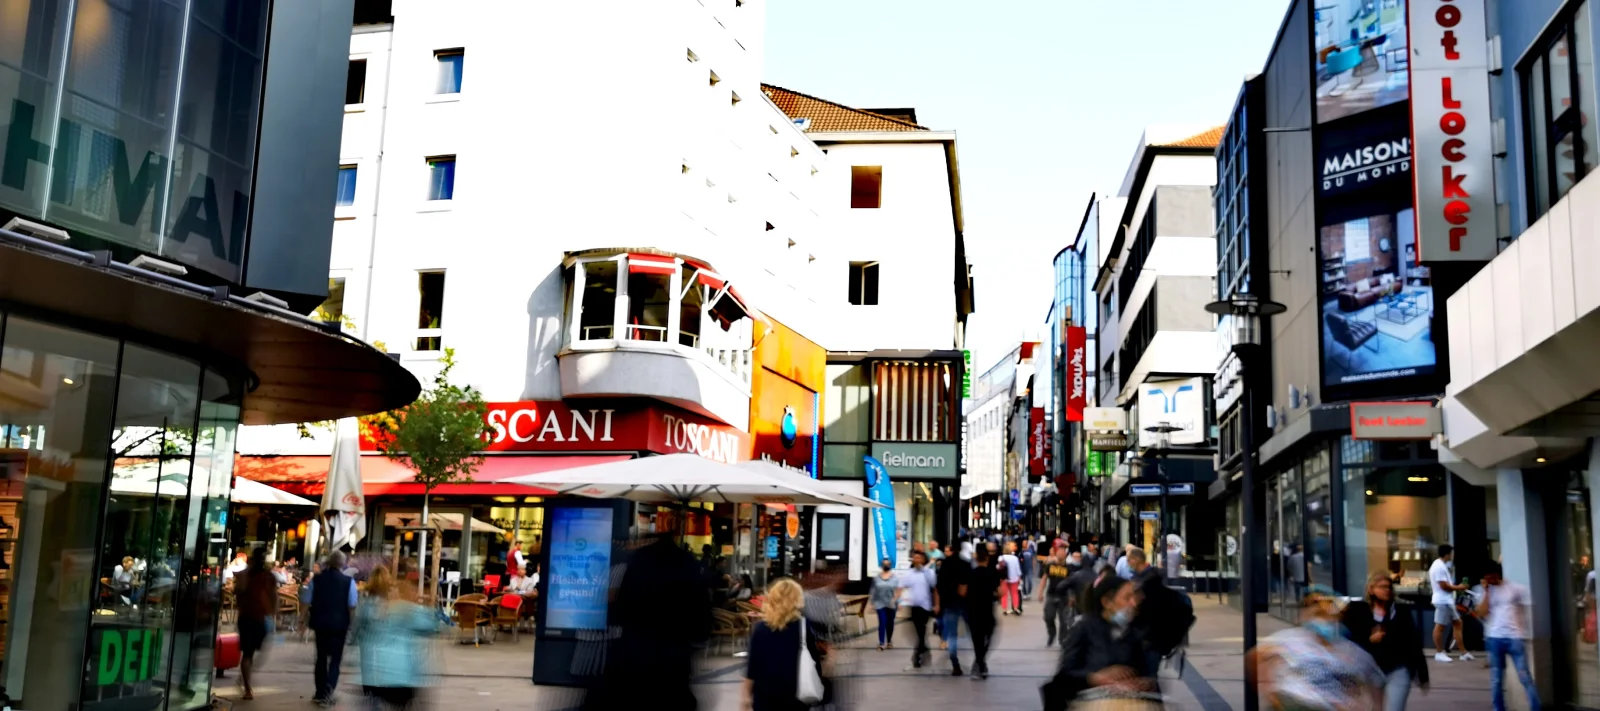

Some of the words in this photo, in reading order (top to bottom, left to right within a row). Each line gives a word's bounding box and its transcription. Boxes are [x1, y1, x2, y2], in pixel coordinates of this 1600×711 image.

[1435, 0, 1461, 60] ot
[1323, 137, 1411, 175] MAISON
[1440, 77, 1471, 252] Locker
[1323, 178, 1344, 190] DU
[1357, 161, 1409, 182] MOND
[1340, 368, 1416, 383] maisonsdumonde.com
[484, 408, 615, 444] SCANI
[663, 414, 740, 465] TOSCANI
[882, 451, 946, 468] fielmann
